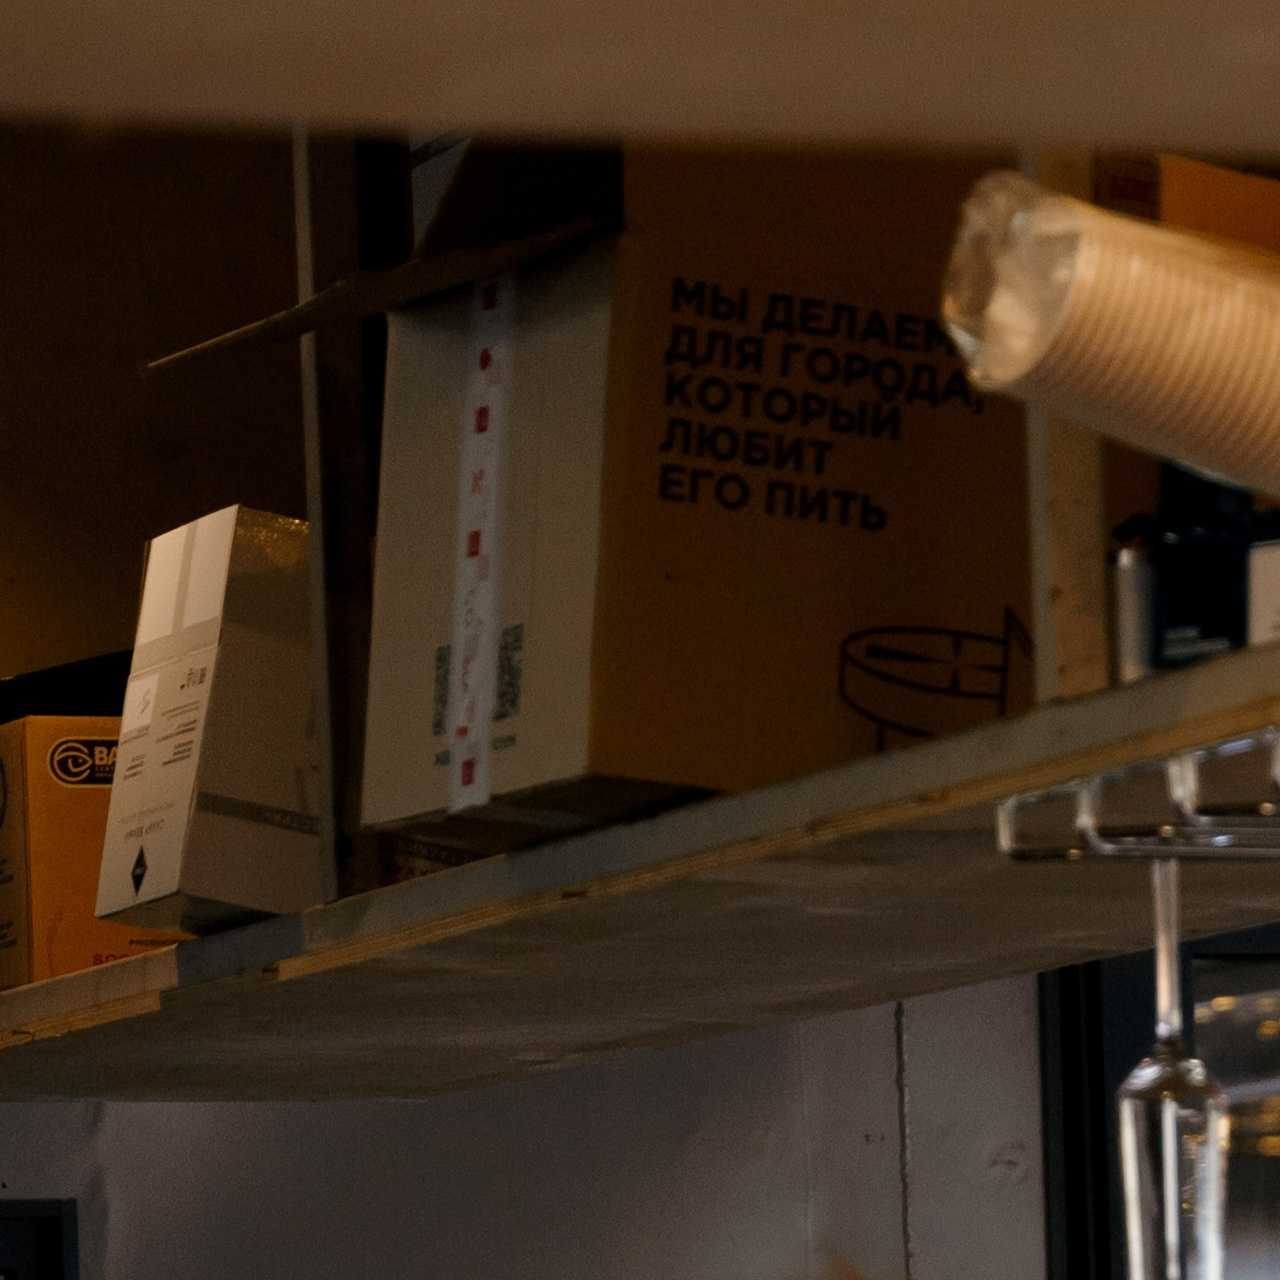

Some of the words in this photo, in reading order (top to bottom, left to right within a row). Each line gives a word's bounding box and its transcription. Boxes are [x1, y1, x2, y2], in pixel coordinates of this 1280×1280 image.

[671, 277, 749, 322] МЫ
[665, 325, 764, 373] ДЛЯ
[780, 342, 987, 414] ГОРОДА,
[665, 373, 902, 441] КОТОРЫЙ
[660, 417, 836, 476] ЛЮБИТ
[659, 463, 750, 511] ЕГО
[765, 479, 887, 530] ПИТЬ
